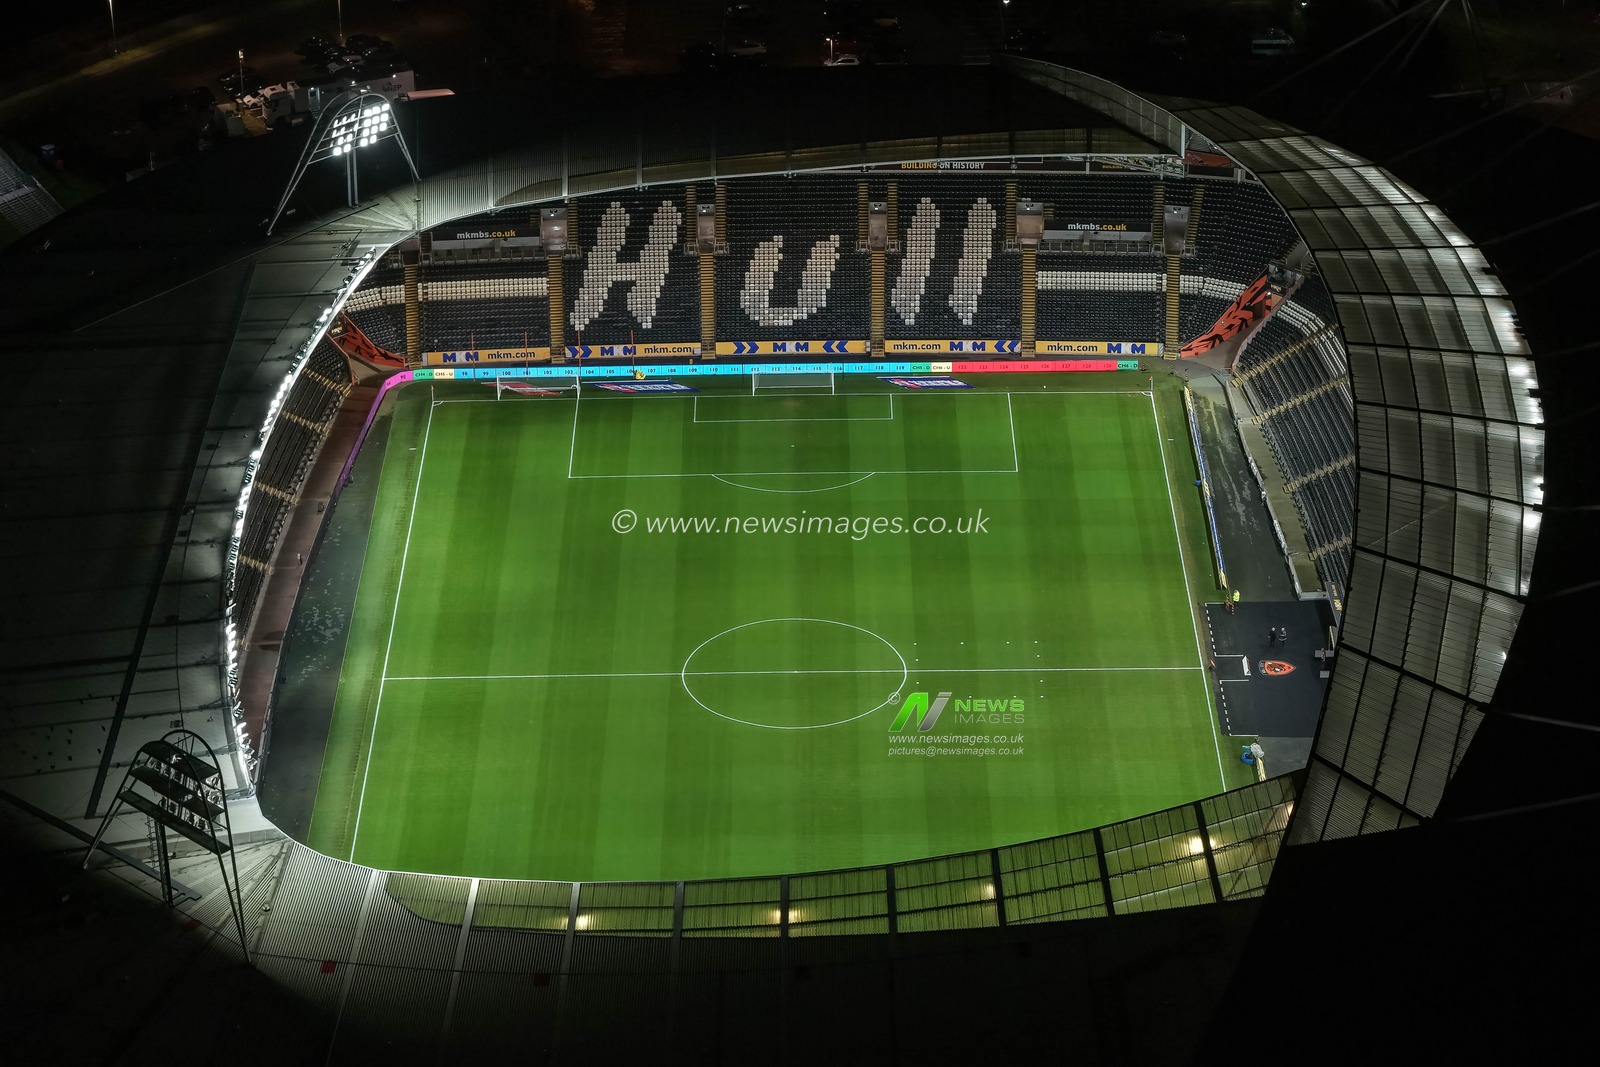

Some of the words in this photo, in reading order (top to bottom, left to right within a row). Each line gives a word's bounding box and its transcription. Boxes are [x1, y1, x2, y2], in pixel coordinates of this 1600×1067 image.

[456, 230, 516, 239] mkmbs.co.uk
[600, 346, 636, 356] MKM
[644, 346, 692, 354] mkm.com
[772, 342, 809, 352] MKM
[893, 342, 941, 351] mkm.com
[950, 341, 986, 351] MKM
[1047, 343, 1098, 352] mkm.com
[1107, 343, 1146, 354] MKM
[442, 352, 479, 362] MKM
[487, 351, 536, 360] mkm.com
